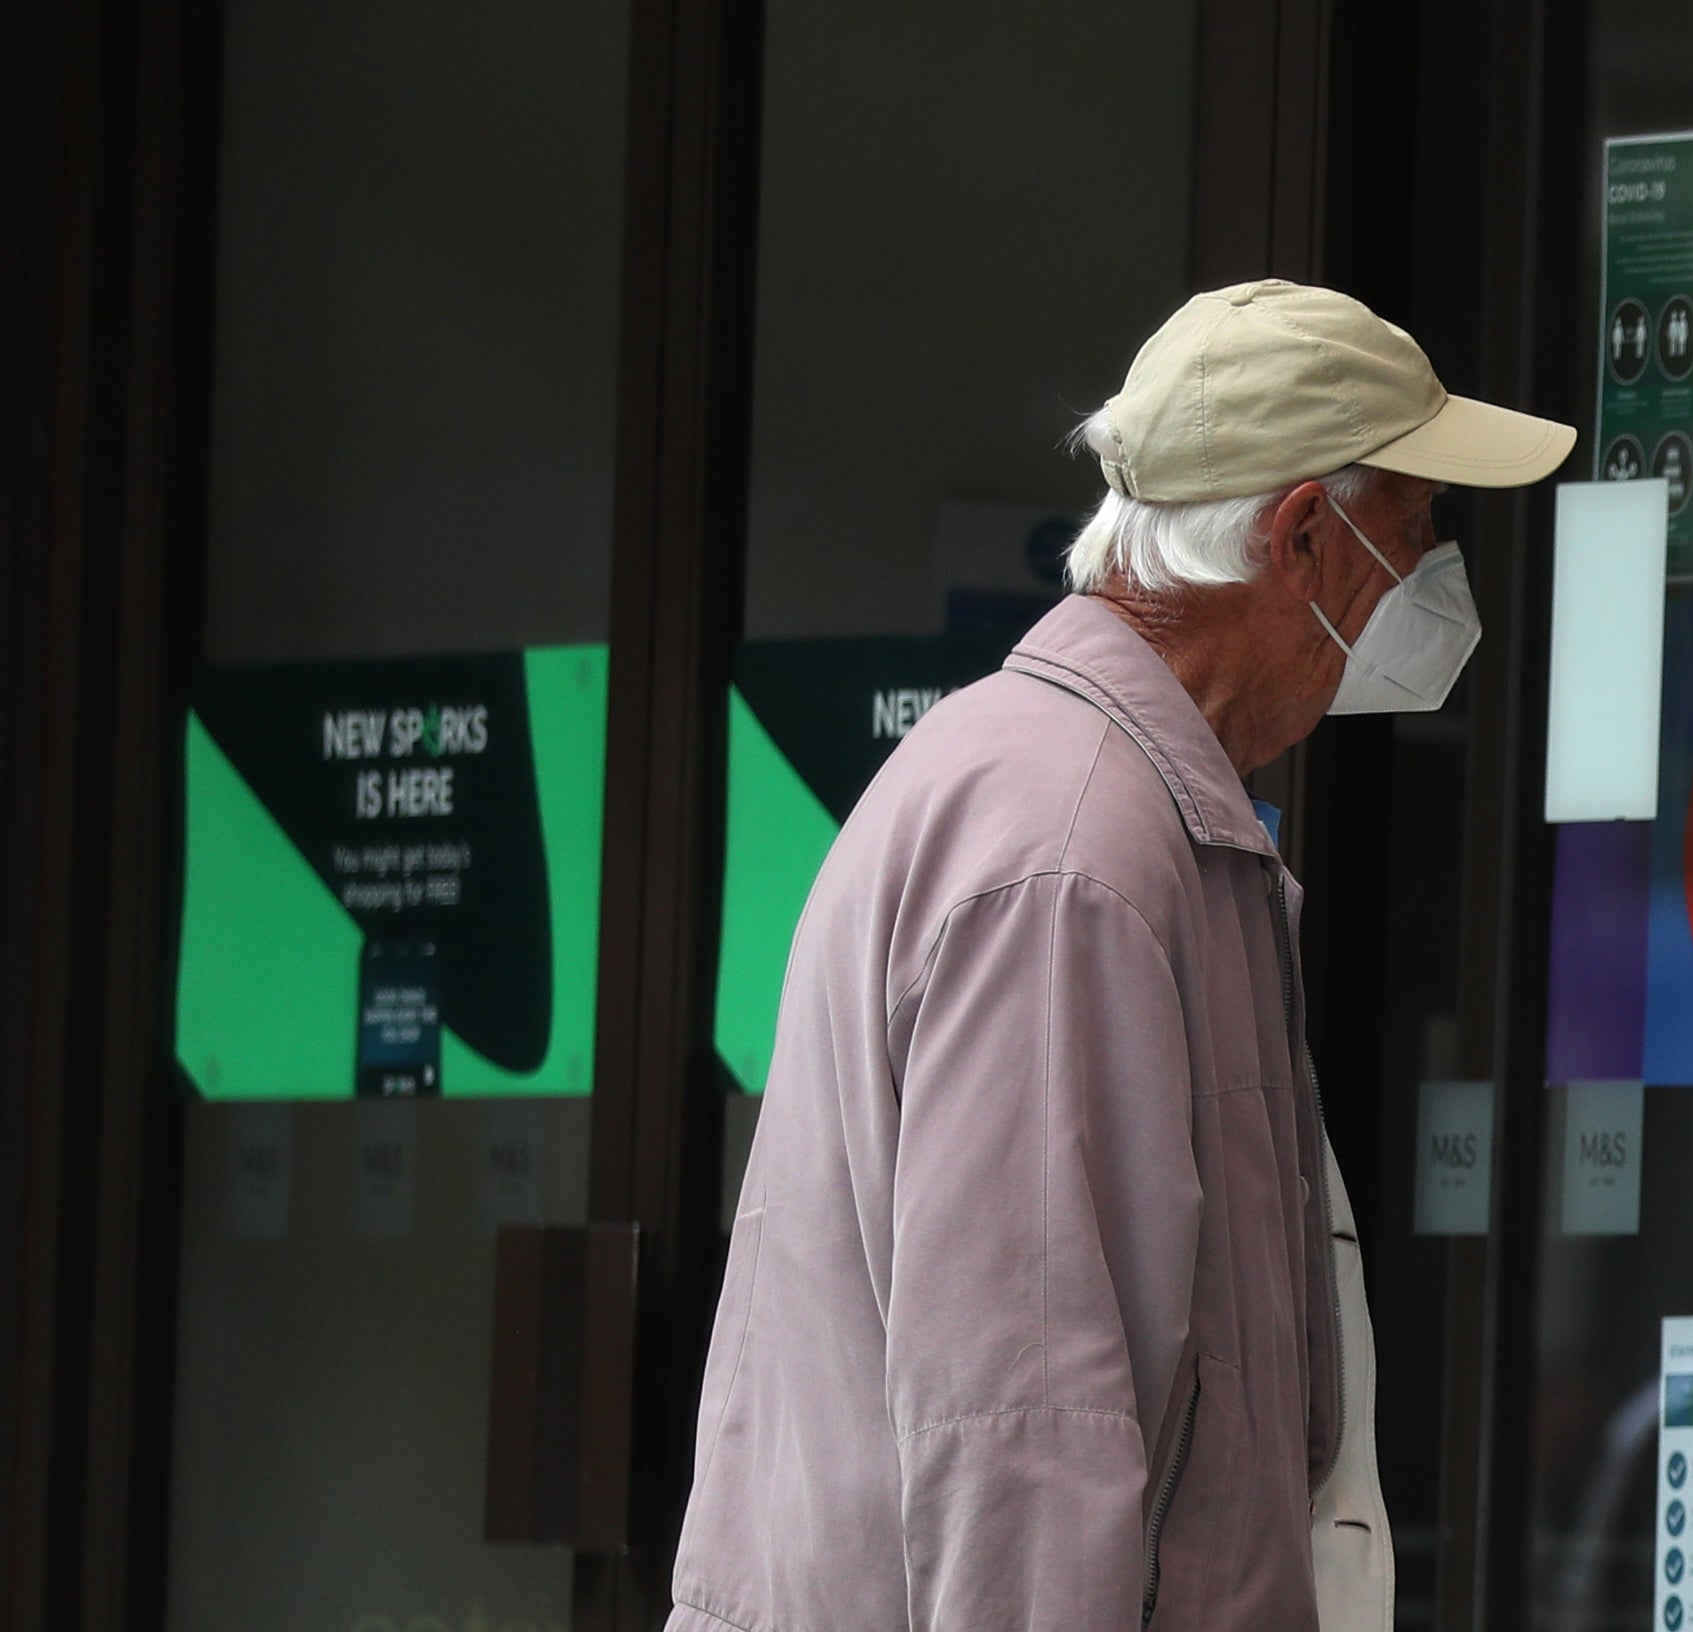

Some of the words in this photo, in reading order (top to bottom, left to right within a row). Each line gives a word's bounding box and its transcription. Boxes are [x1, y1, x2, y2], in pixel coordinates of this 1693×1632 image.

[323, 710, 387, 760] NEW
[389, 703, 488, 759] SPARKS
[356, 770, 382, 818] IS
[387, 766, 454, 817] HERE
[1431, 1132, 1477, 1170] M&S
[1579, 1131, 1627, 1168] M&S
